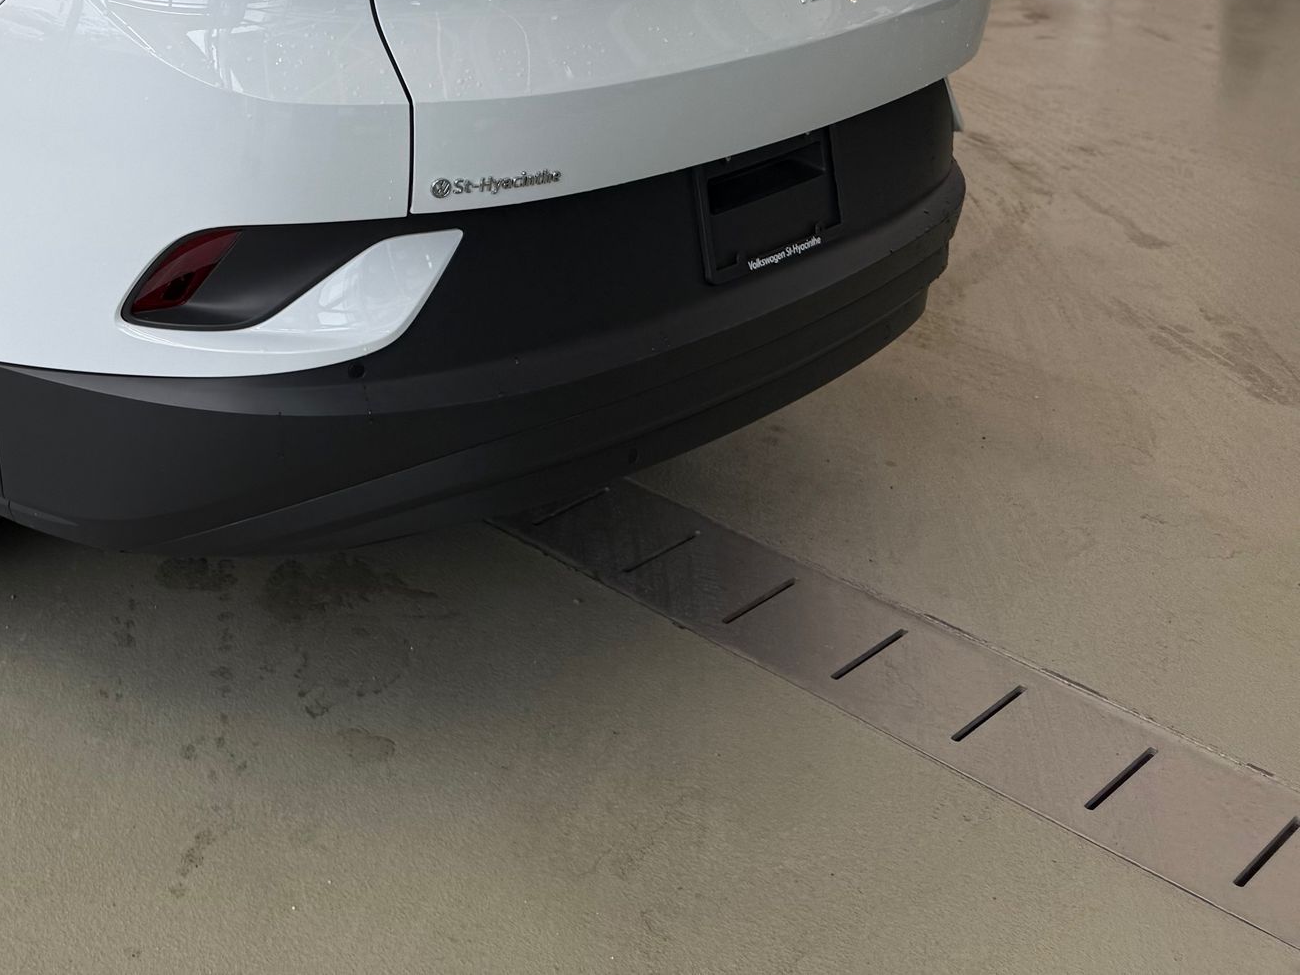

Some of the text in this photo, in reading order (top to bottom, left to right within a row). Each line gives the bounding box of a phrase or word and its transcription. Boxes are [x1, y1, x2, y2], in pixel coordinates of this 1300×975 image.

[452, 168, 562, 195] St-Hyacinthe
[747, 235, 822, 271] Volkswagen St-Hyacinthe
